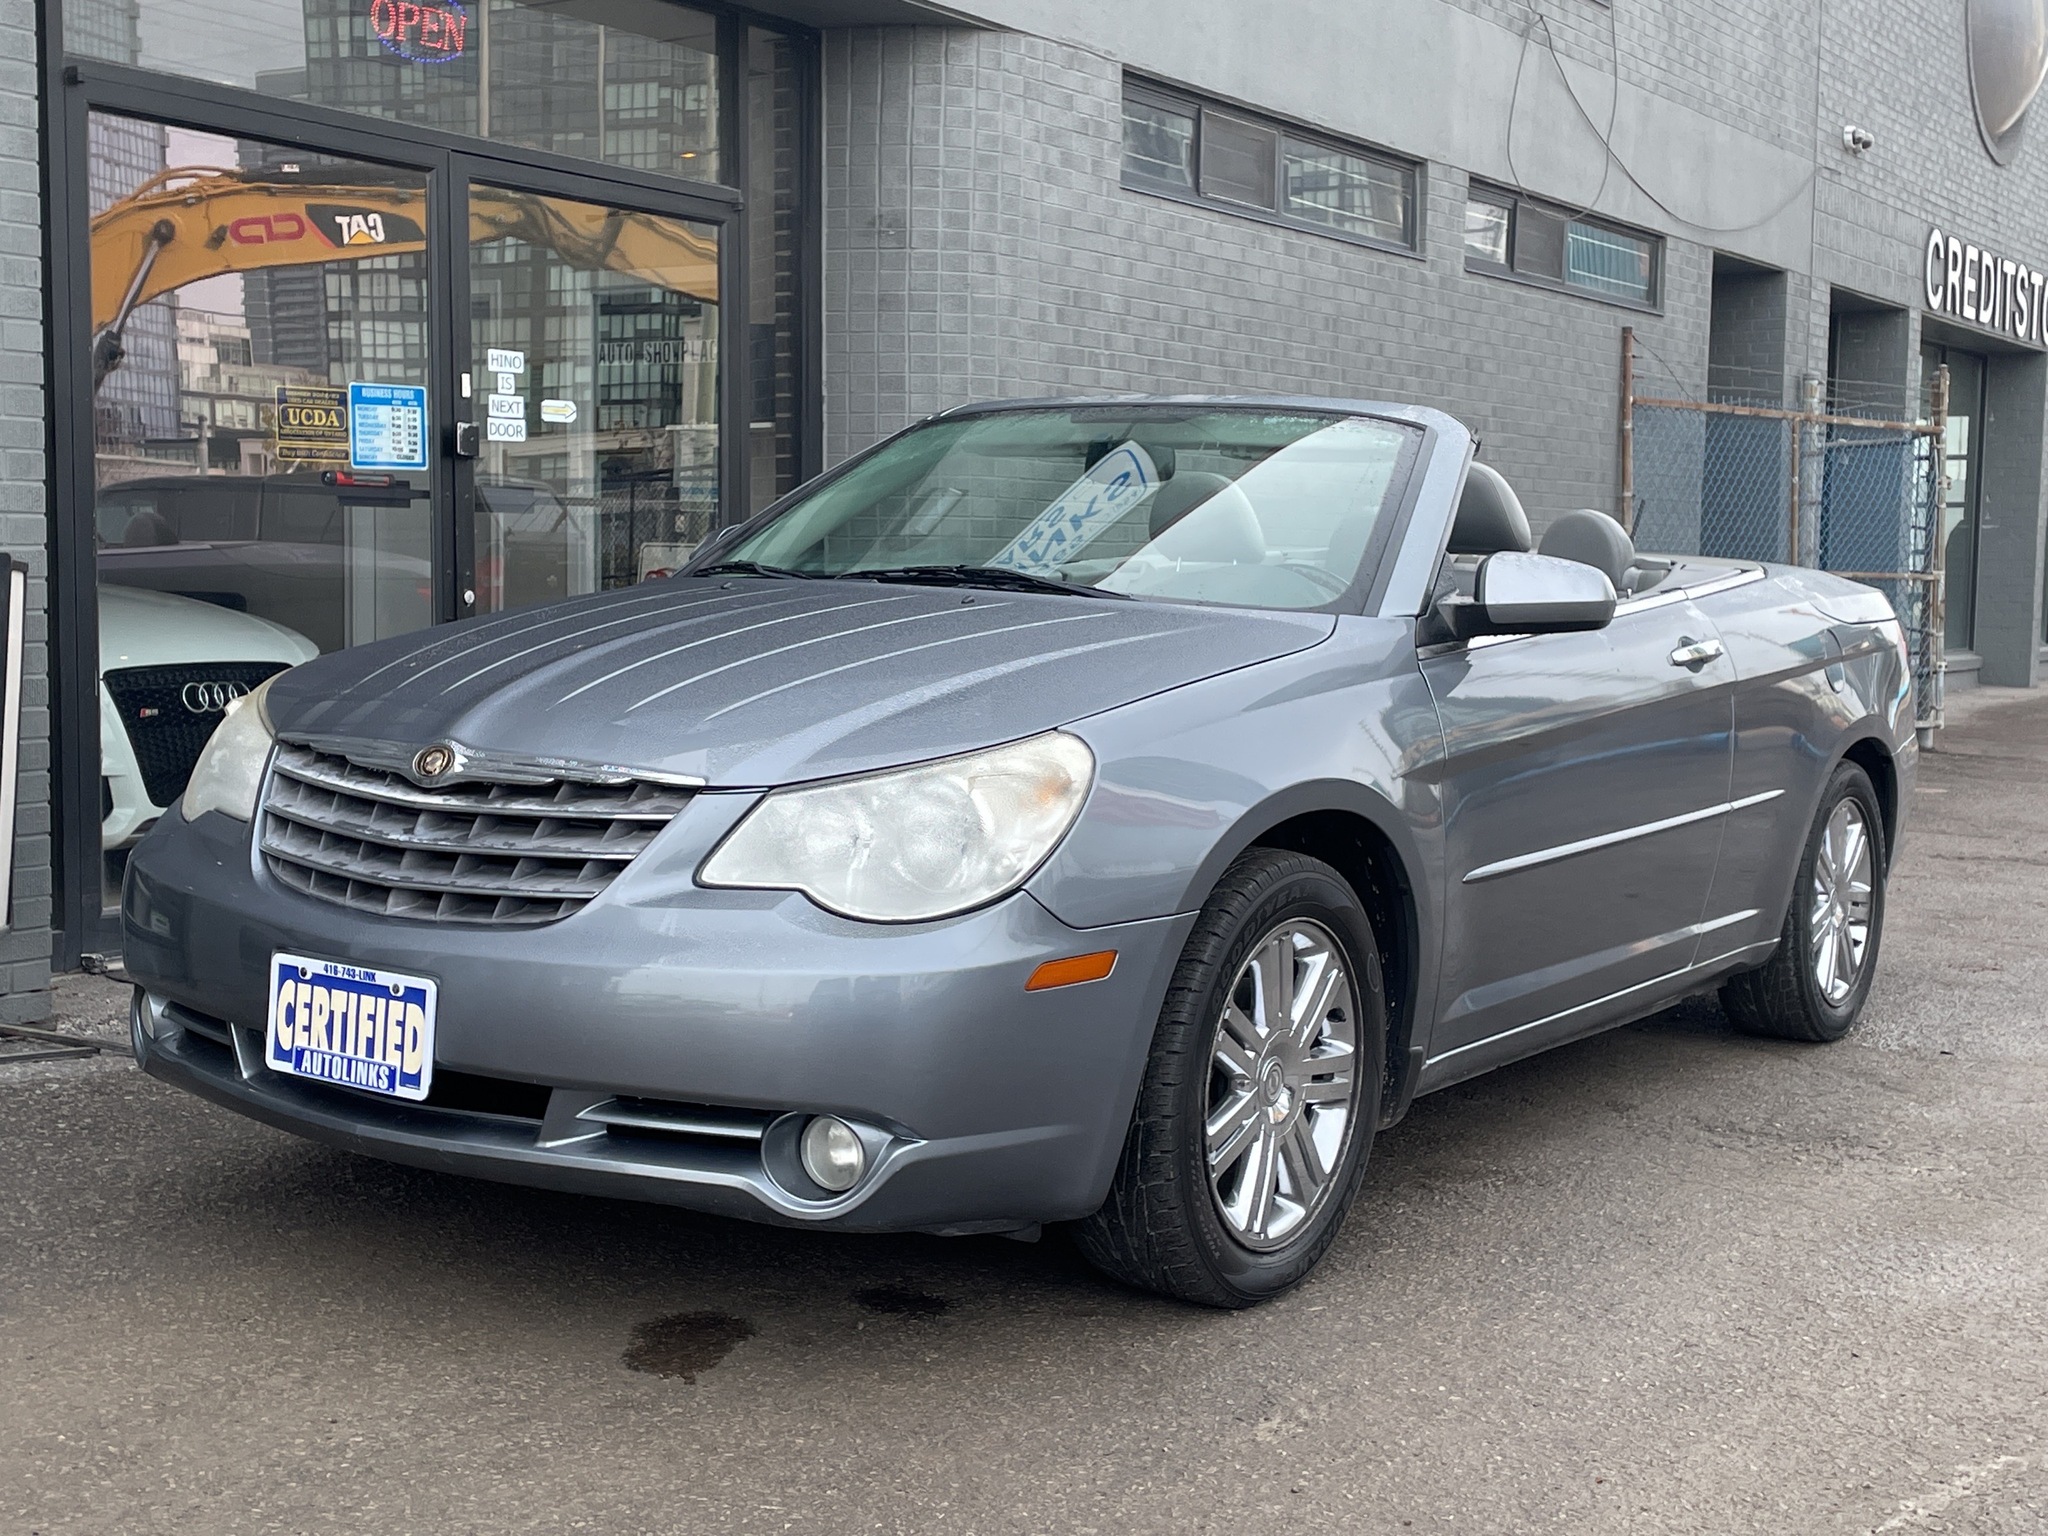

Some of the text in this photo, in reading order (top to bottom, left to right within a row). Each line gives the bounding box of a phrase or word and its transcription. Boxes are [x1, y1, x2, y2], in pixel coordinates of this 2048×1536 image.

[370, 0, 467, 51] OPEN
[491, 353, 522, 369] HINO
[599, 343, 634, 364] AUTO
[501, 376, 512, 390] IS
[491, 399, 522, 414] NEXT
[287, 408, 340, 427] UCDA
[489, 422, 524, 438] DOOR
[277, 979, 425, 1075] CERTIFIED
[301, 1050, 389, 1091] AUTOLINKS
